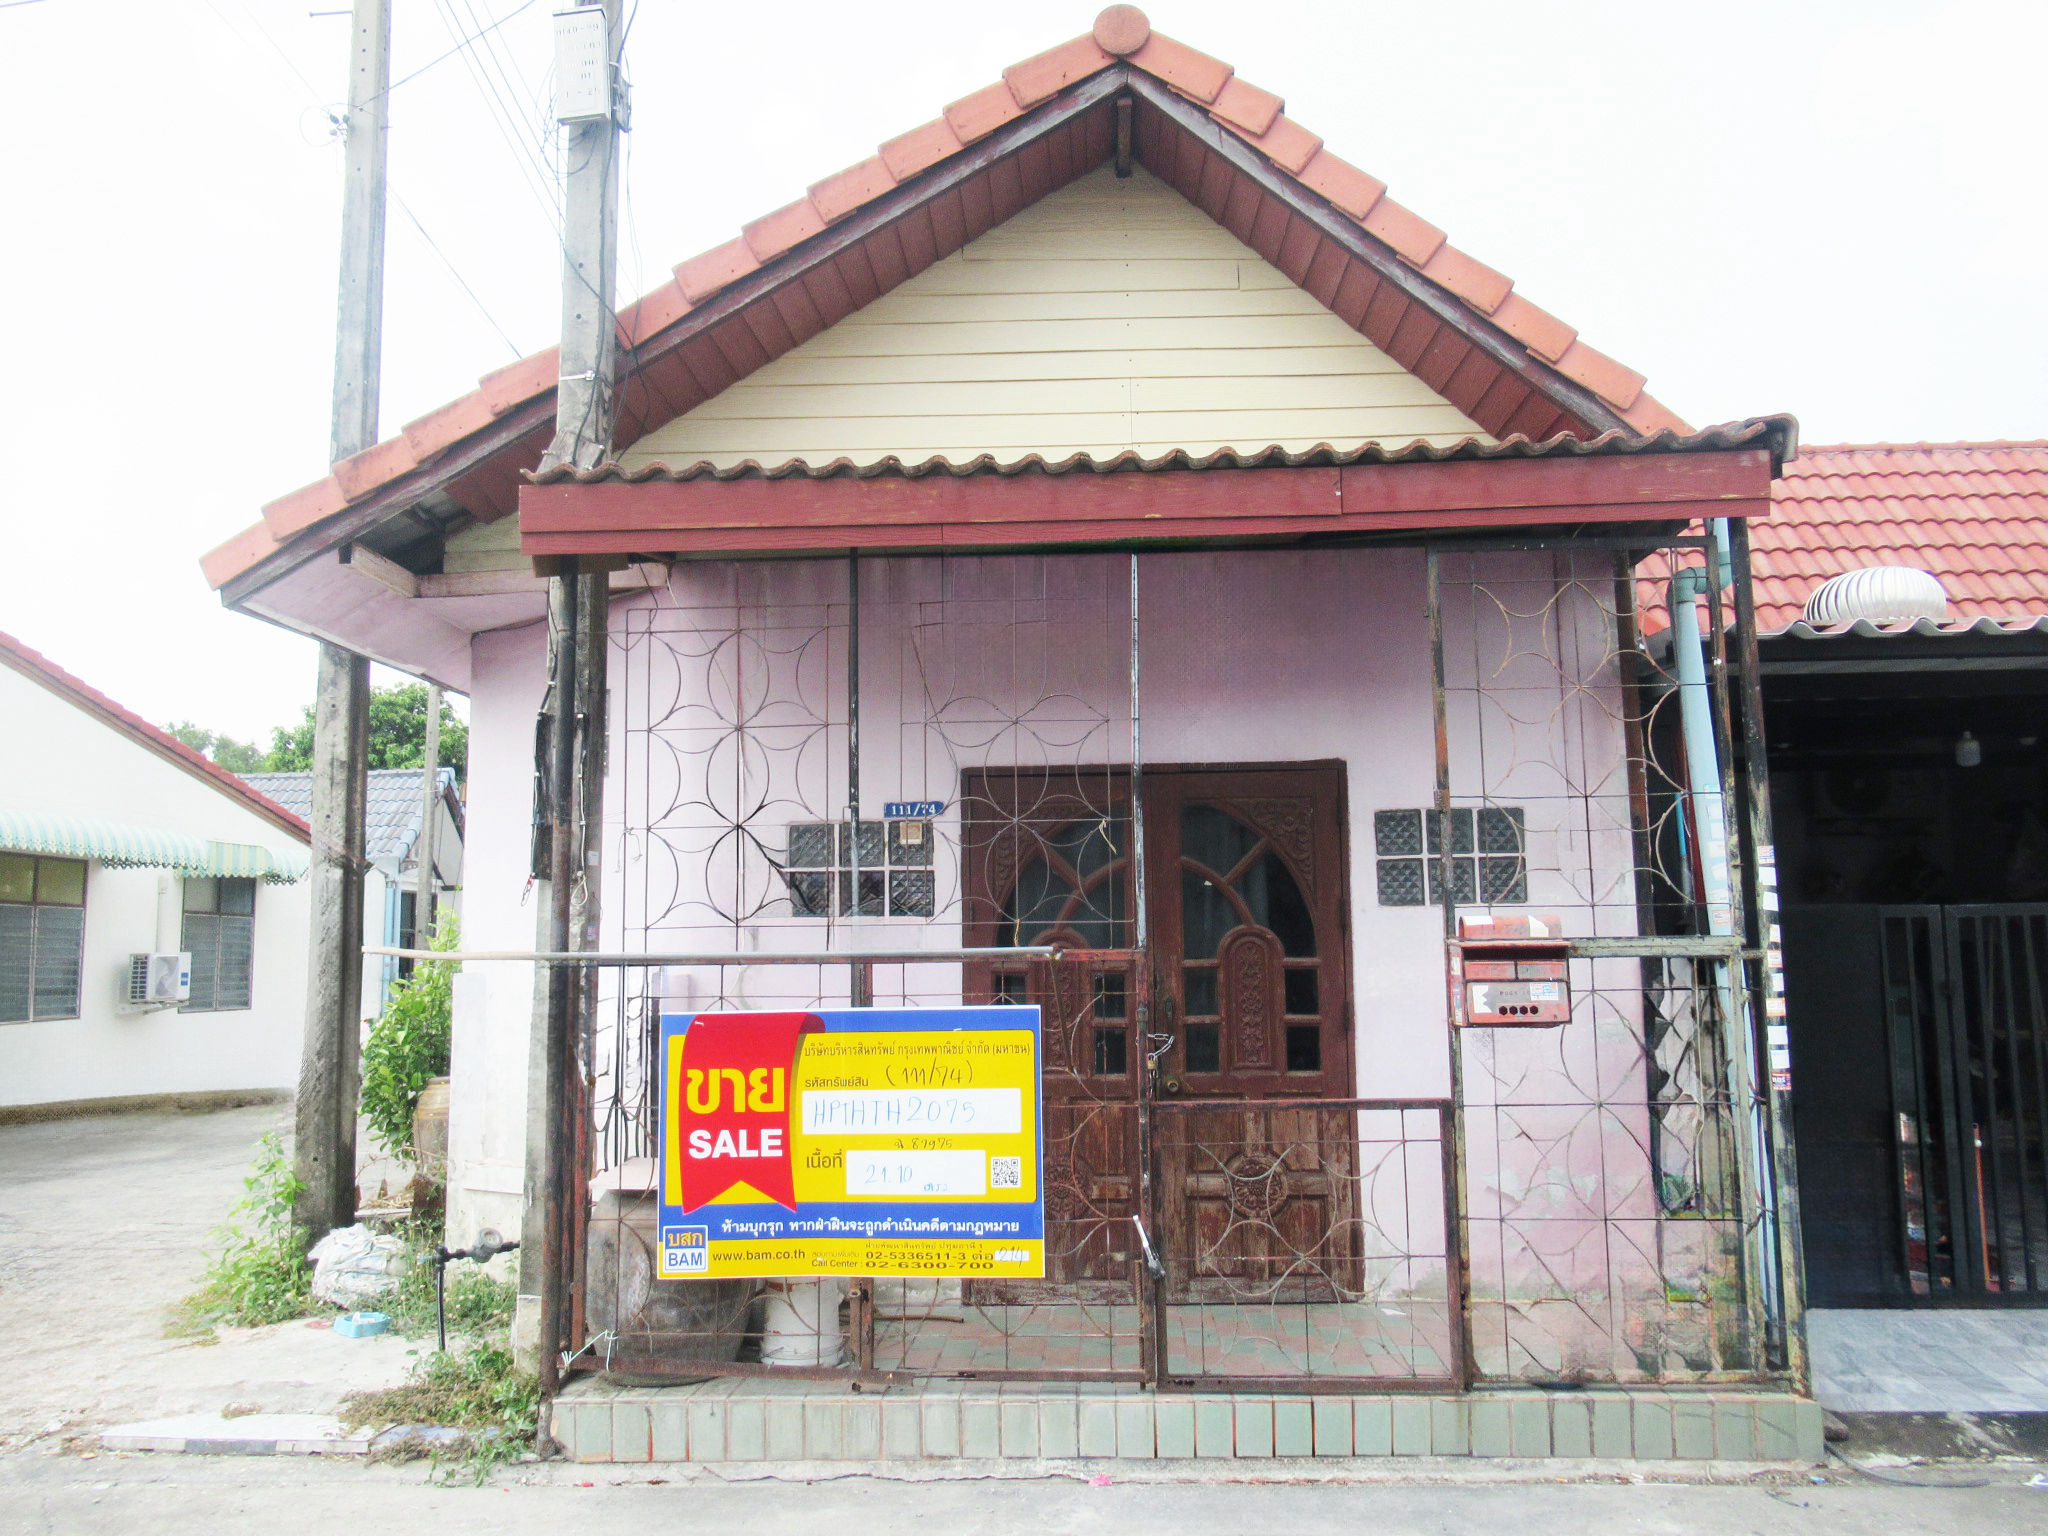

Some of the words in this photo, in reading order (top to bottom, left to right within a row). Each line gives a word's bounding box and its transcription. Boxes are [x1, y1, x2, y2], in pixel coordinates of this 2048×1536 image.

[891, 803, 936, 816] 111/74
[966, 1040, 989, 1055] จำกัด
[992, 1042, 1031, 1056] (มหาชน)
[804, 1076, 869, 1088] รหัสทรัพย์สิน
[686, 1067, 785, 1114] ขาย
[688, 1128, 783, 1159] SALE
[806, 1148, 843, 1169] เนื้อที่
[721, 1218, 784, 1237] ห้ามบุกรุก
[667, 1231, 704, 1247] บสก
[668, 1252, 703, 1267] BAM
[712, 1248, 806, 1262] www.bam.co.th
[865, 1251, 966, 1260] 02-5336511-3
[972, 1249, 994, 1260] ต่อ
[811, 1259, 828, 1268] Call
[829, 1259, 858, 1268] Center
[865, 1260, 995, 1270] 02-6300-700
